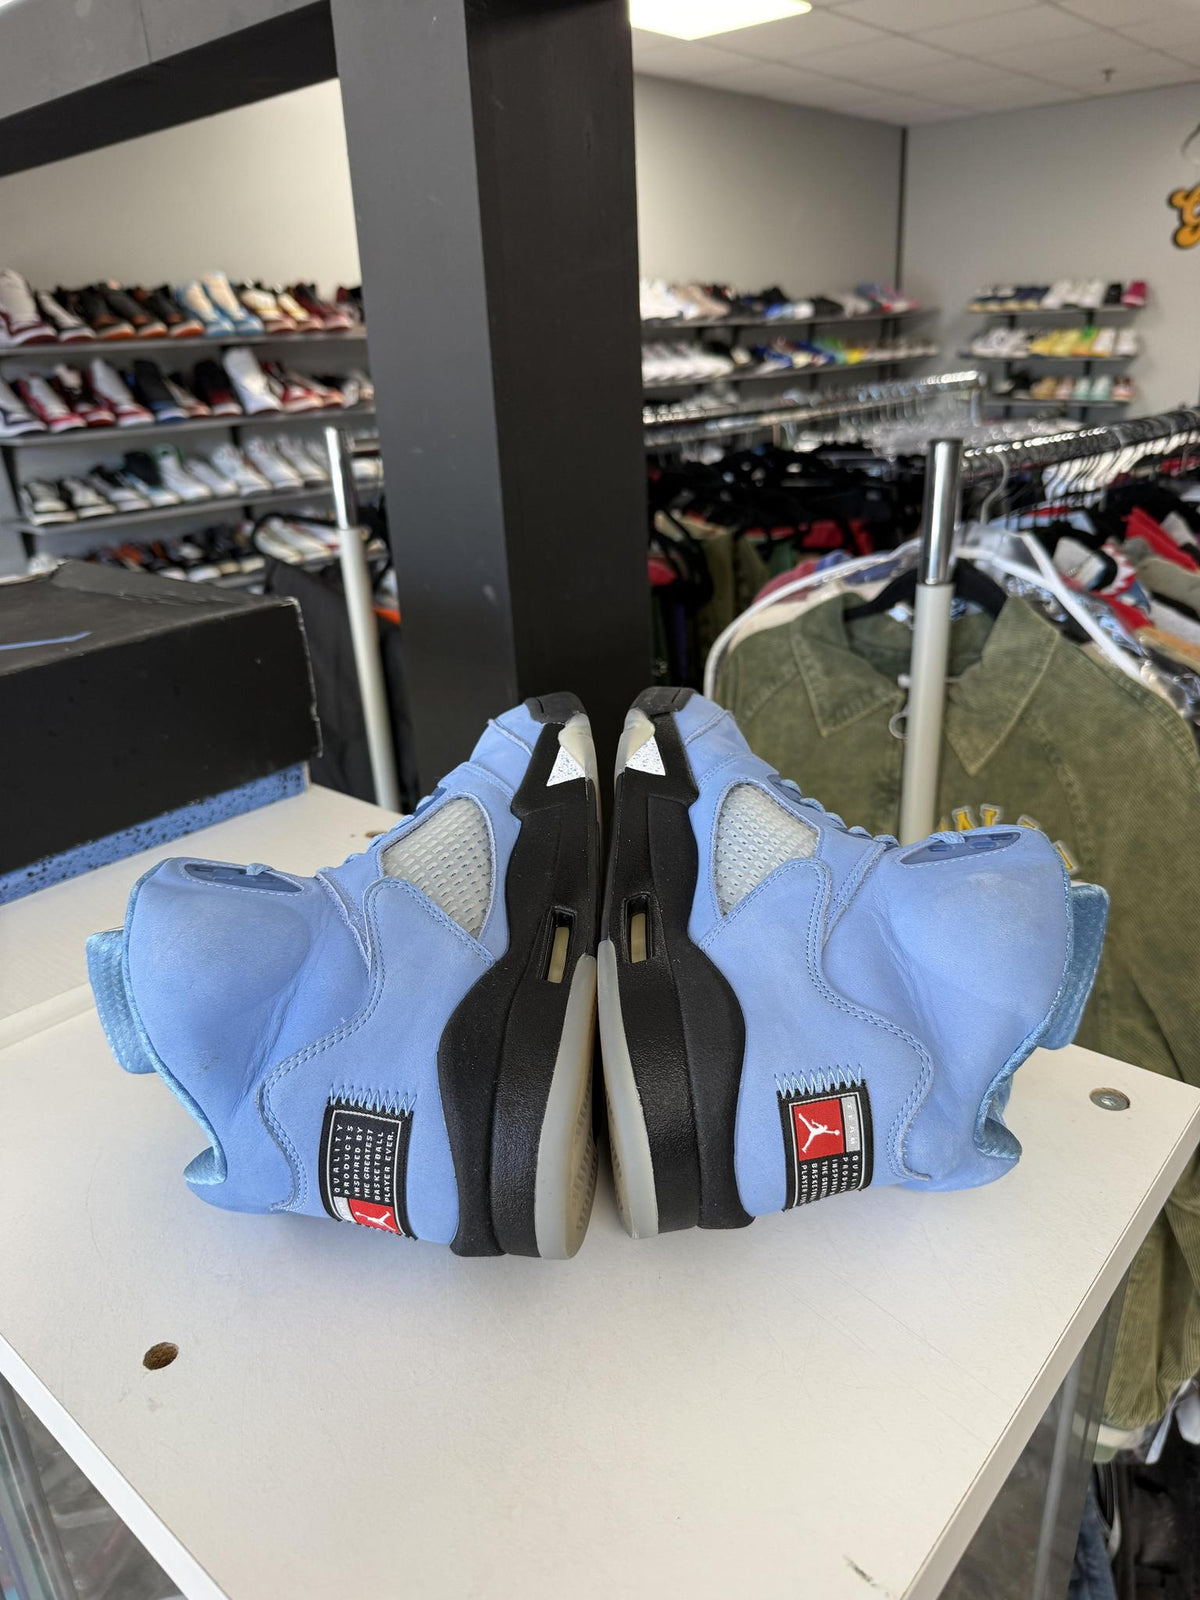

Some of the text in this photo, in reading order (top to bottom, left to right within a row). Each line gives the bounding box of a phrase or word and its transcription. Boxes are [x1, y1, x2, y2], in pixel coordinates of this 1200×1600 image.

[333, 1124, 344, 1193] QUALITY
[356, 1127, 364, 1141] BY
[364, 1129, 374, 1180] GREATEST
[385, 1131, 394, 1162] EVER.
[343, 1125, 353, 1195] PRODUCTS
[374, 1132, 384, 1201] BASKETBALL
[800, 1165, 808, 1193] PLAYER
